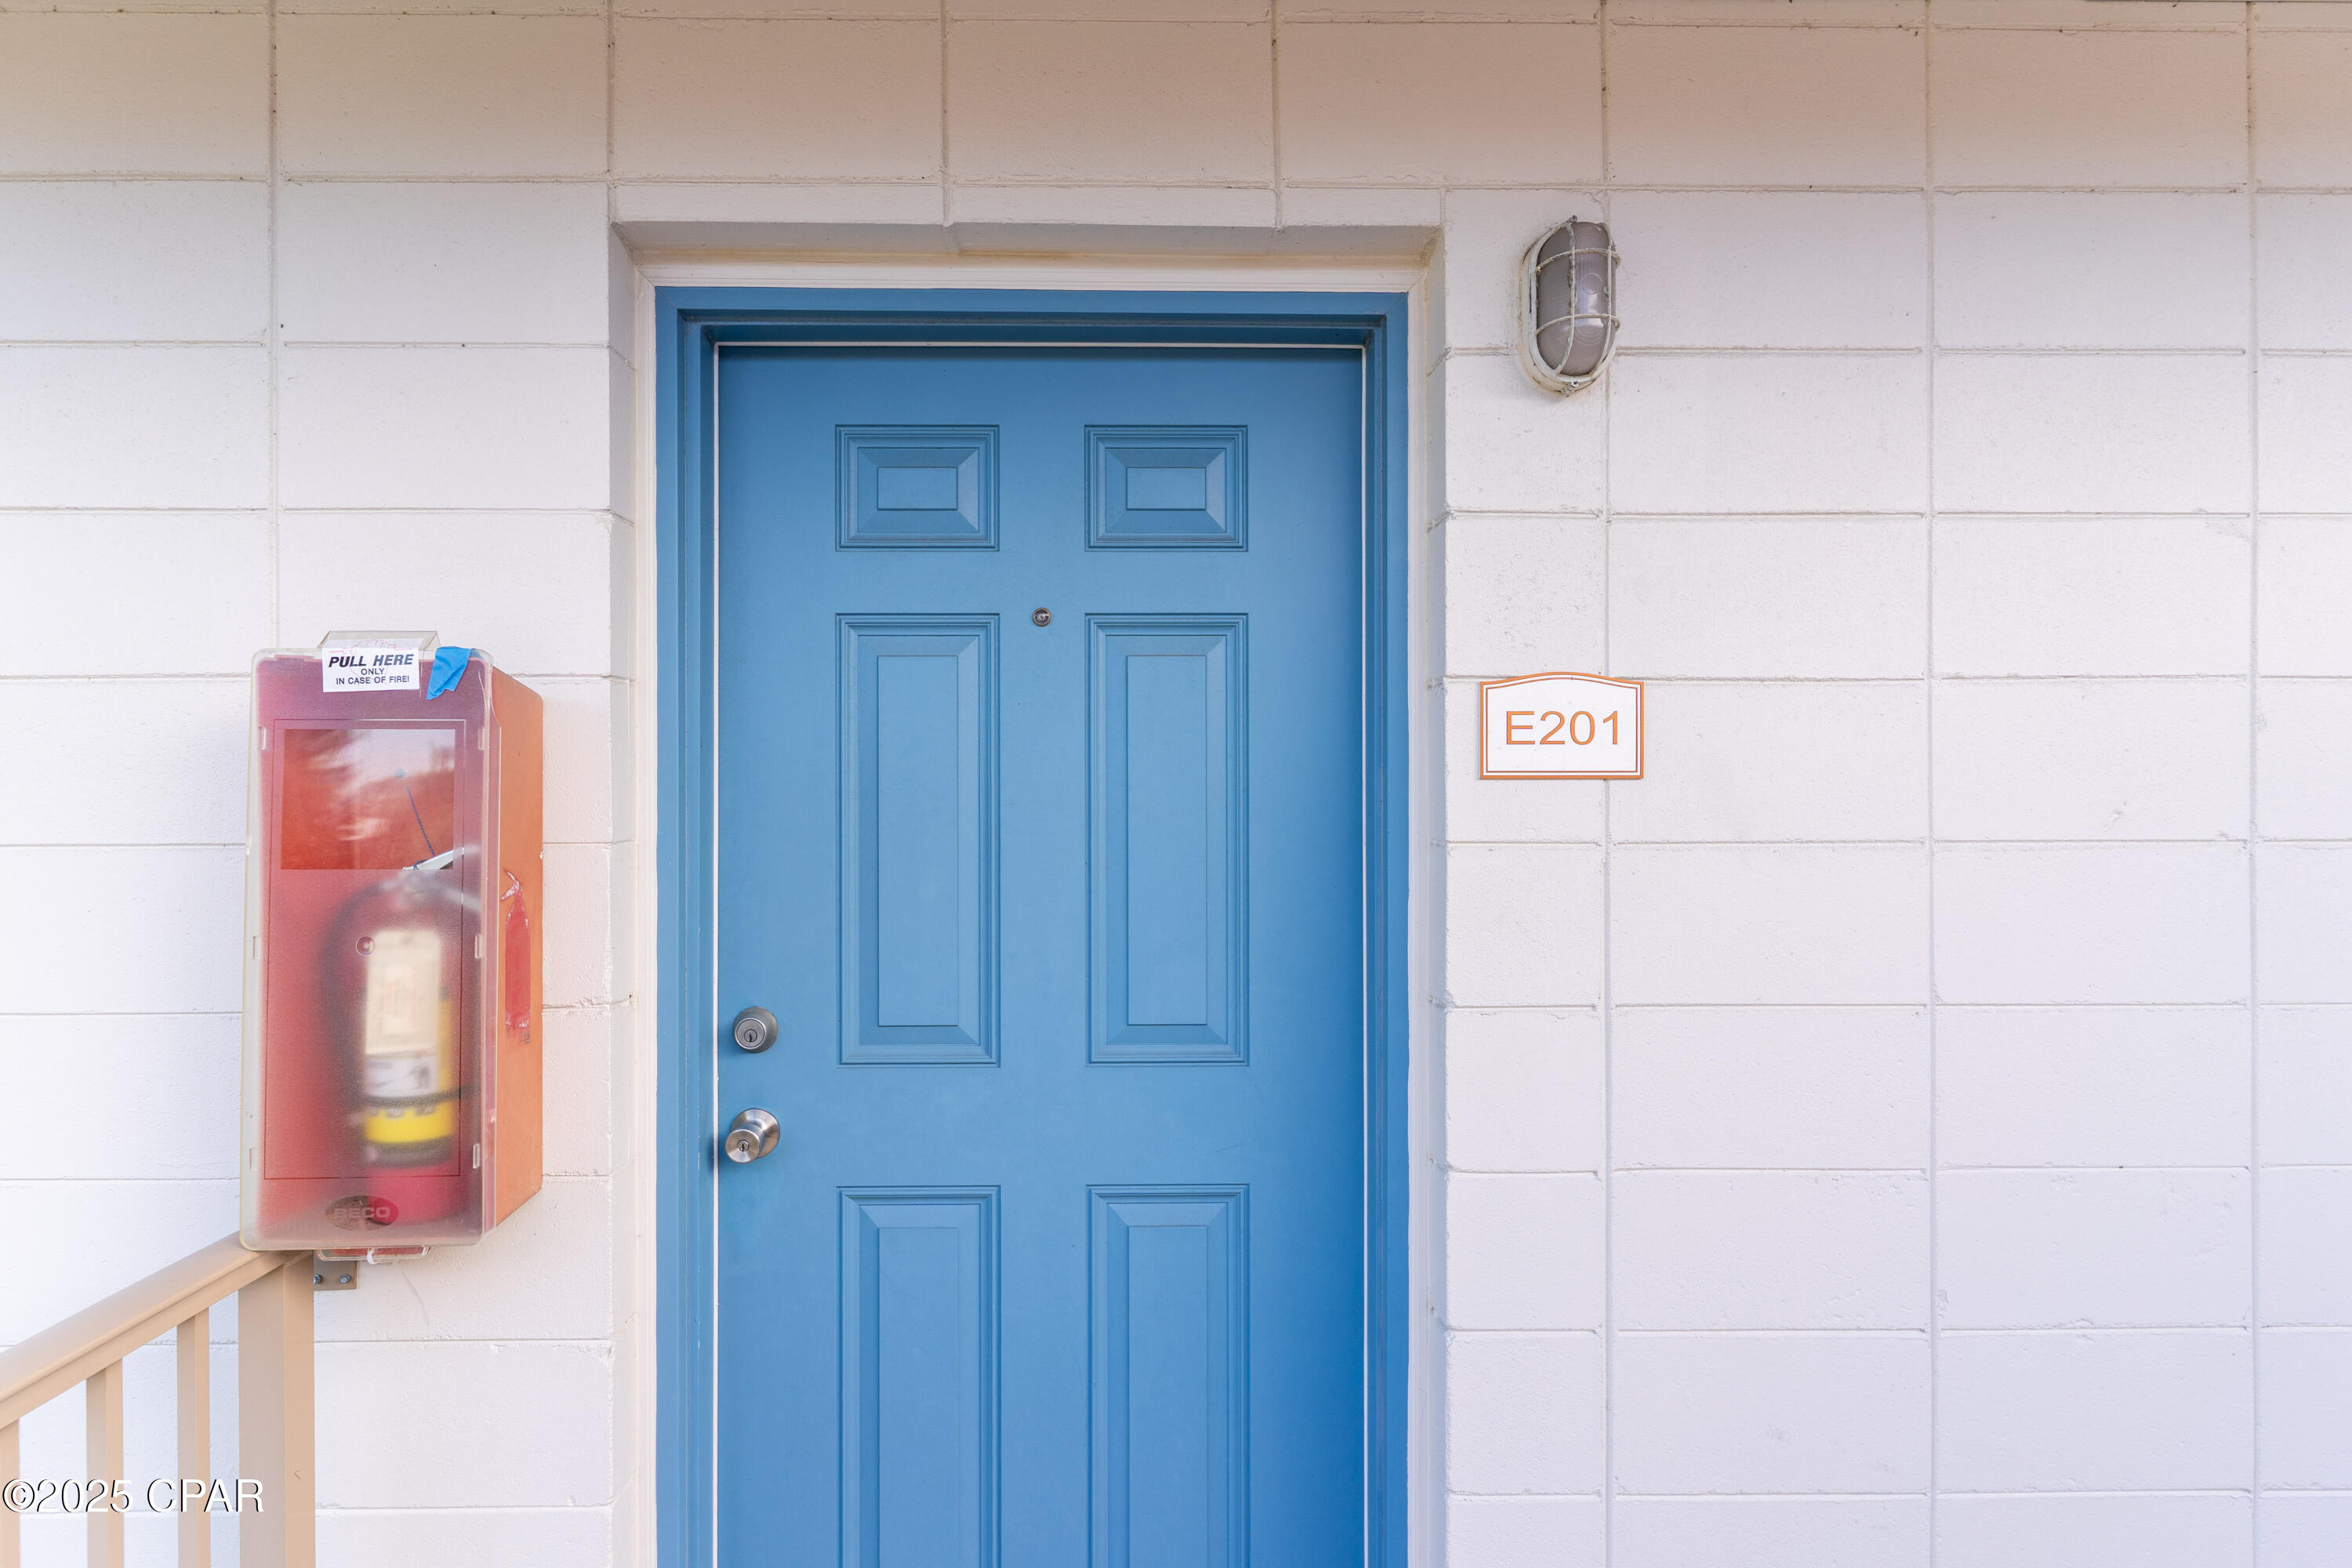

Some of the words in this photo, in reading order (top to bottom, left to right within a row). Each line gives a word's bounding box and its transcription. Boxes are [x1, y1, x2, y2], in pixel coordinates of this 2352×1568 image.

[328, 655, 367, 667] PULL
[373, 654, 414, 666] HERE
[1506, 710, 1618, 745] E201
